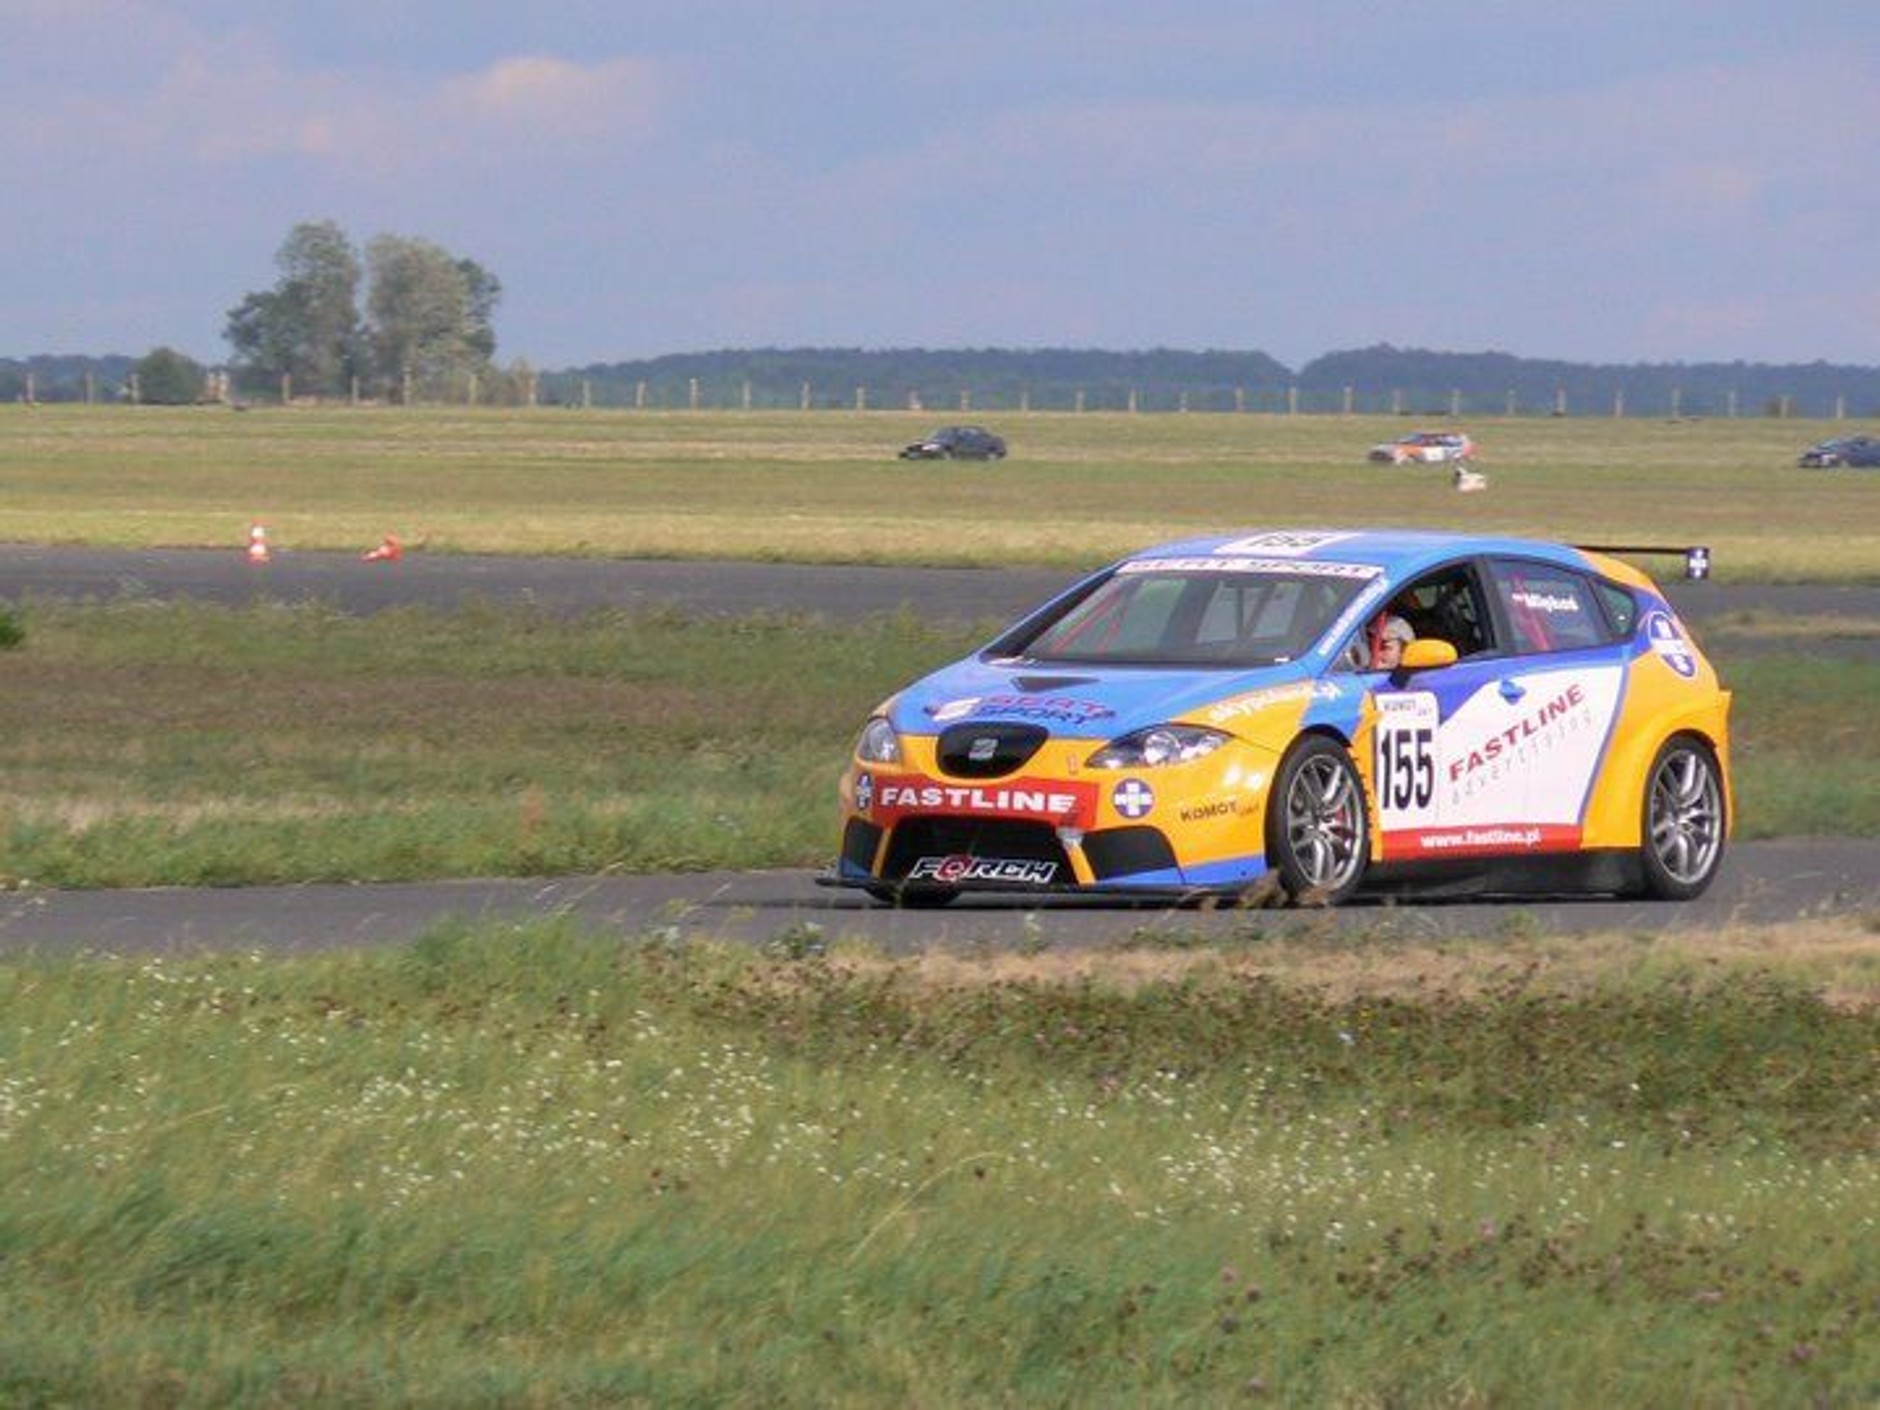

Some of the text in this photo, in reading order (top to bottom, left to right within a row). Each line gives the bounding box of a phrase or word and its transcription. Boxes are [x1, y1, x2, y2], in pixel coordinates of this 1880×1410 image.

[1449, 683, 1586, 783] FASTLINE
[1381, 728, 1434, 810] 155
[880, 786, 1077, 813] FASTLINE
[1420, 827, 1542, 848] www.fastline.pl
